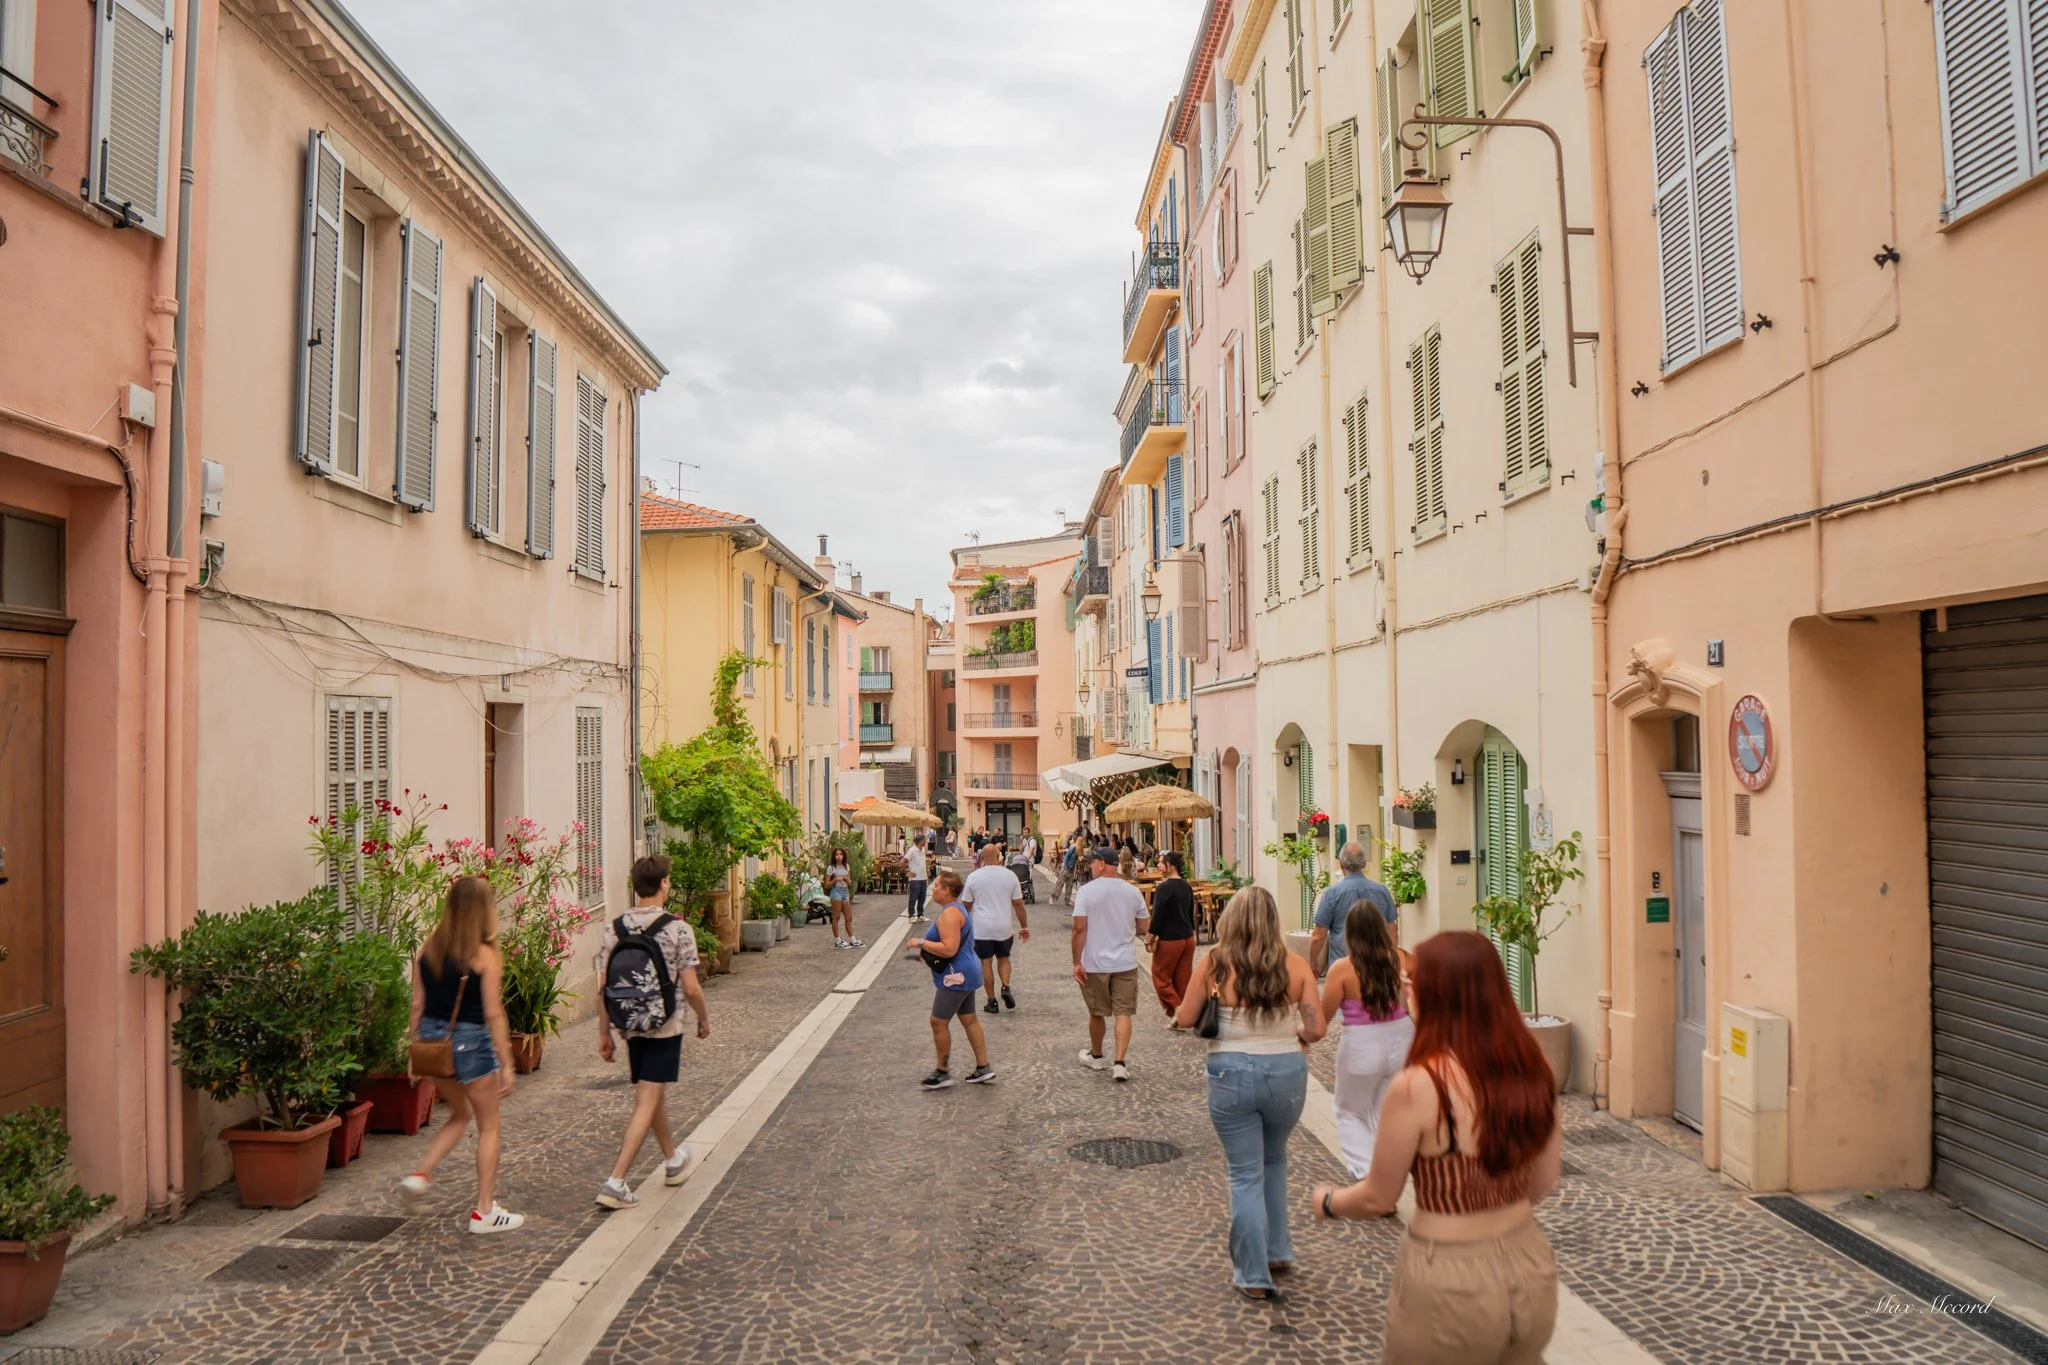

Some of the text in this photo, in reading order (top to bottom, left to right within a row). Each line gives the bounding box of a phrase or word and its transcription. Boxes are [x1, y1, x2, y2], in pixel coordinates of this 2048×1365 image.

[1710, 644, 1719, 662] 21
[1734, 697, 1767, 722] GARAGE
[1738, 735, 1764, 749] SORTIE
[1734, 756, 1749, 784] JOUR
[1755, 756, 1771, 784] NUIT
